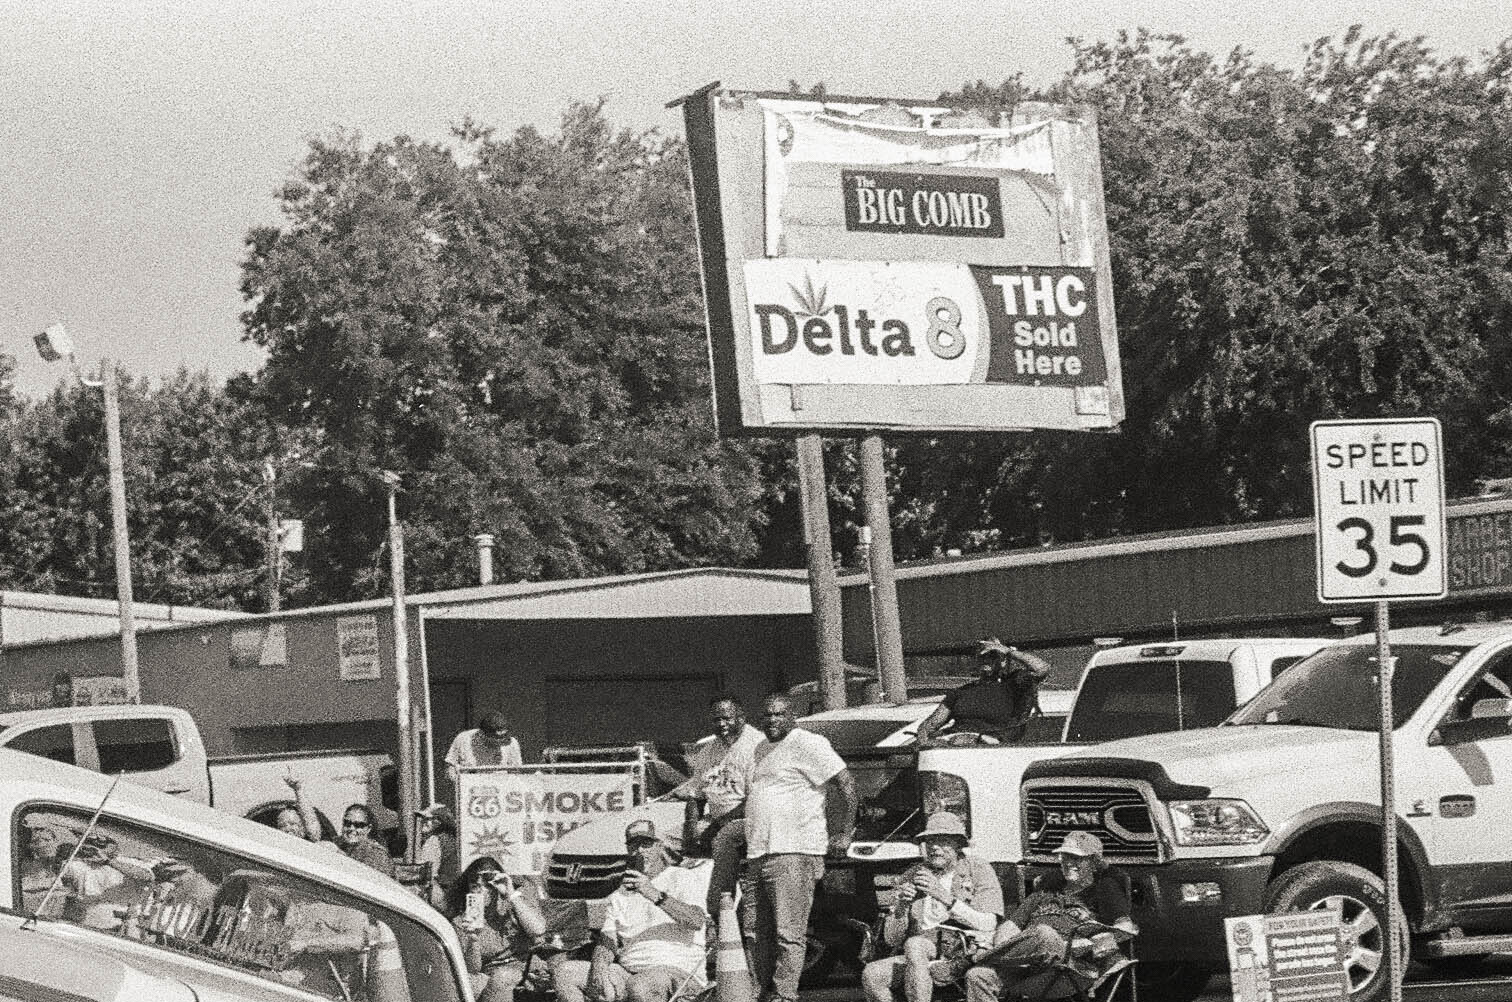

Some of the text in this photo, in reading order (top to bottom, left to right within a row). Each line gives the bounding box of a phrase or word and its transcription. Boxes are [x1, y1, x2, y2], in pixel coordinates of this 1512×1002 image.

[856, 188, 992, 229] BIG COMB
[992, 274, 1088, 319] THC
[753, 295, 968, 361] Delta 8
[1013, 320, 1078, 349] Sold
[1013, 348, 1083, 377] Here
[1325, 441, 1430, 469] SPEED
[1339, 478, 1419, 505] LIMIT
[1335, 514, 1432, 579] 35
[470, 790, 625, 817] 66 SMOKE
[1046, 811, 1101, 825] RAM
